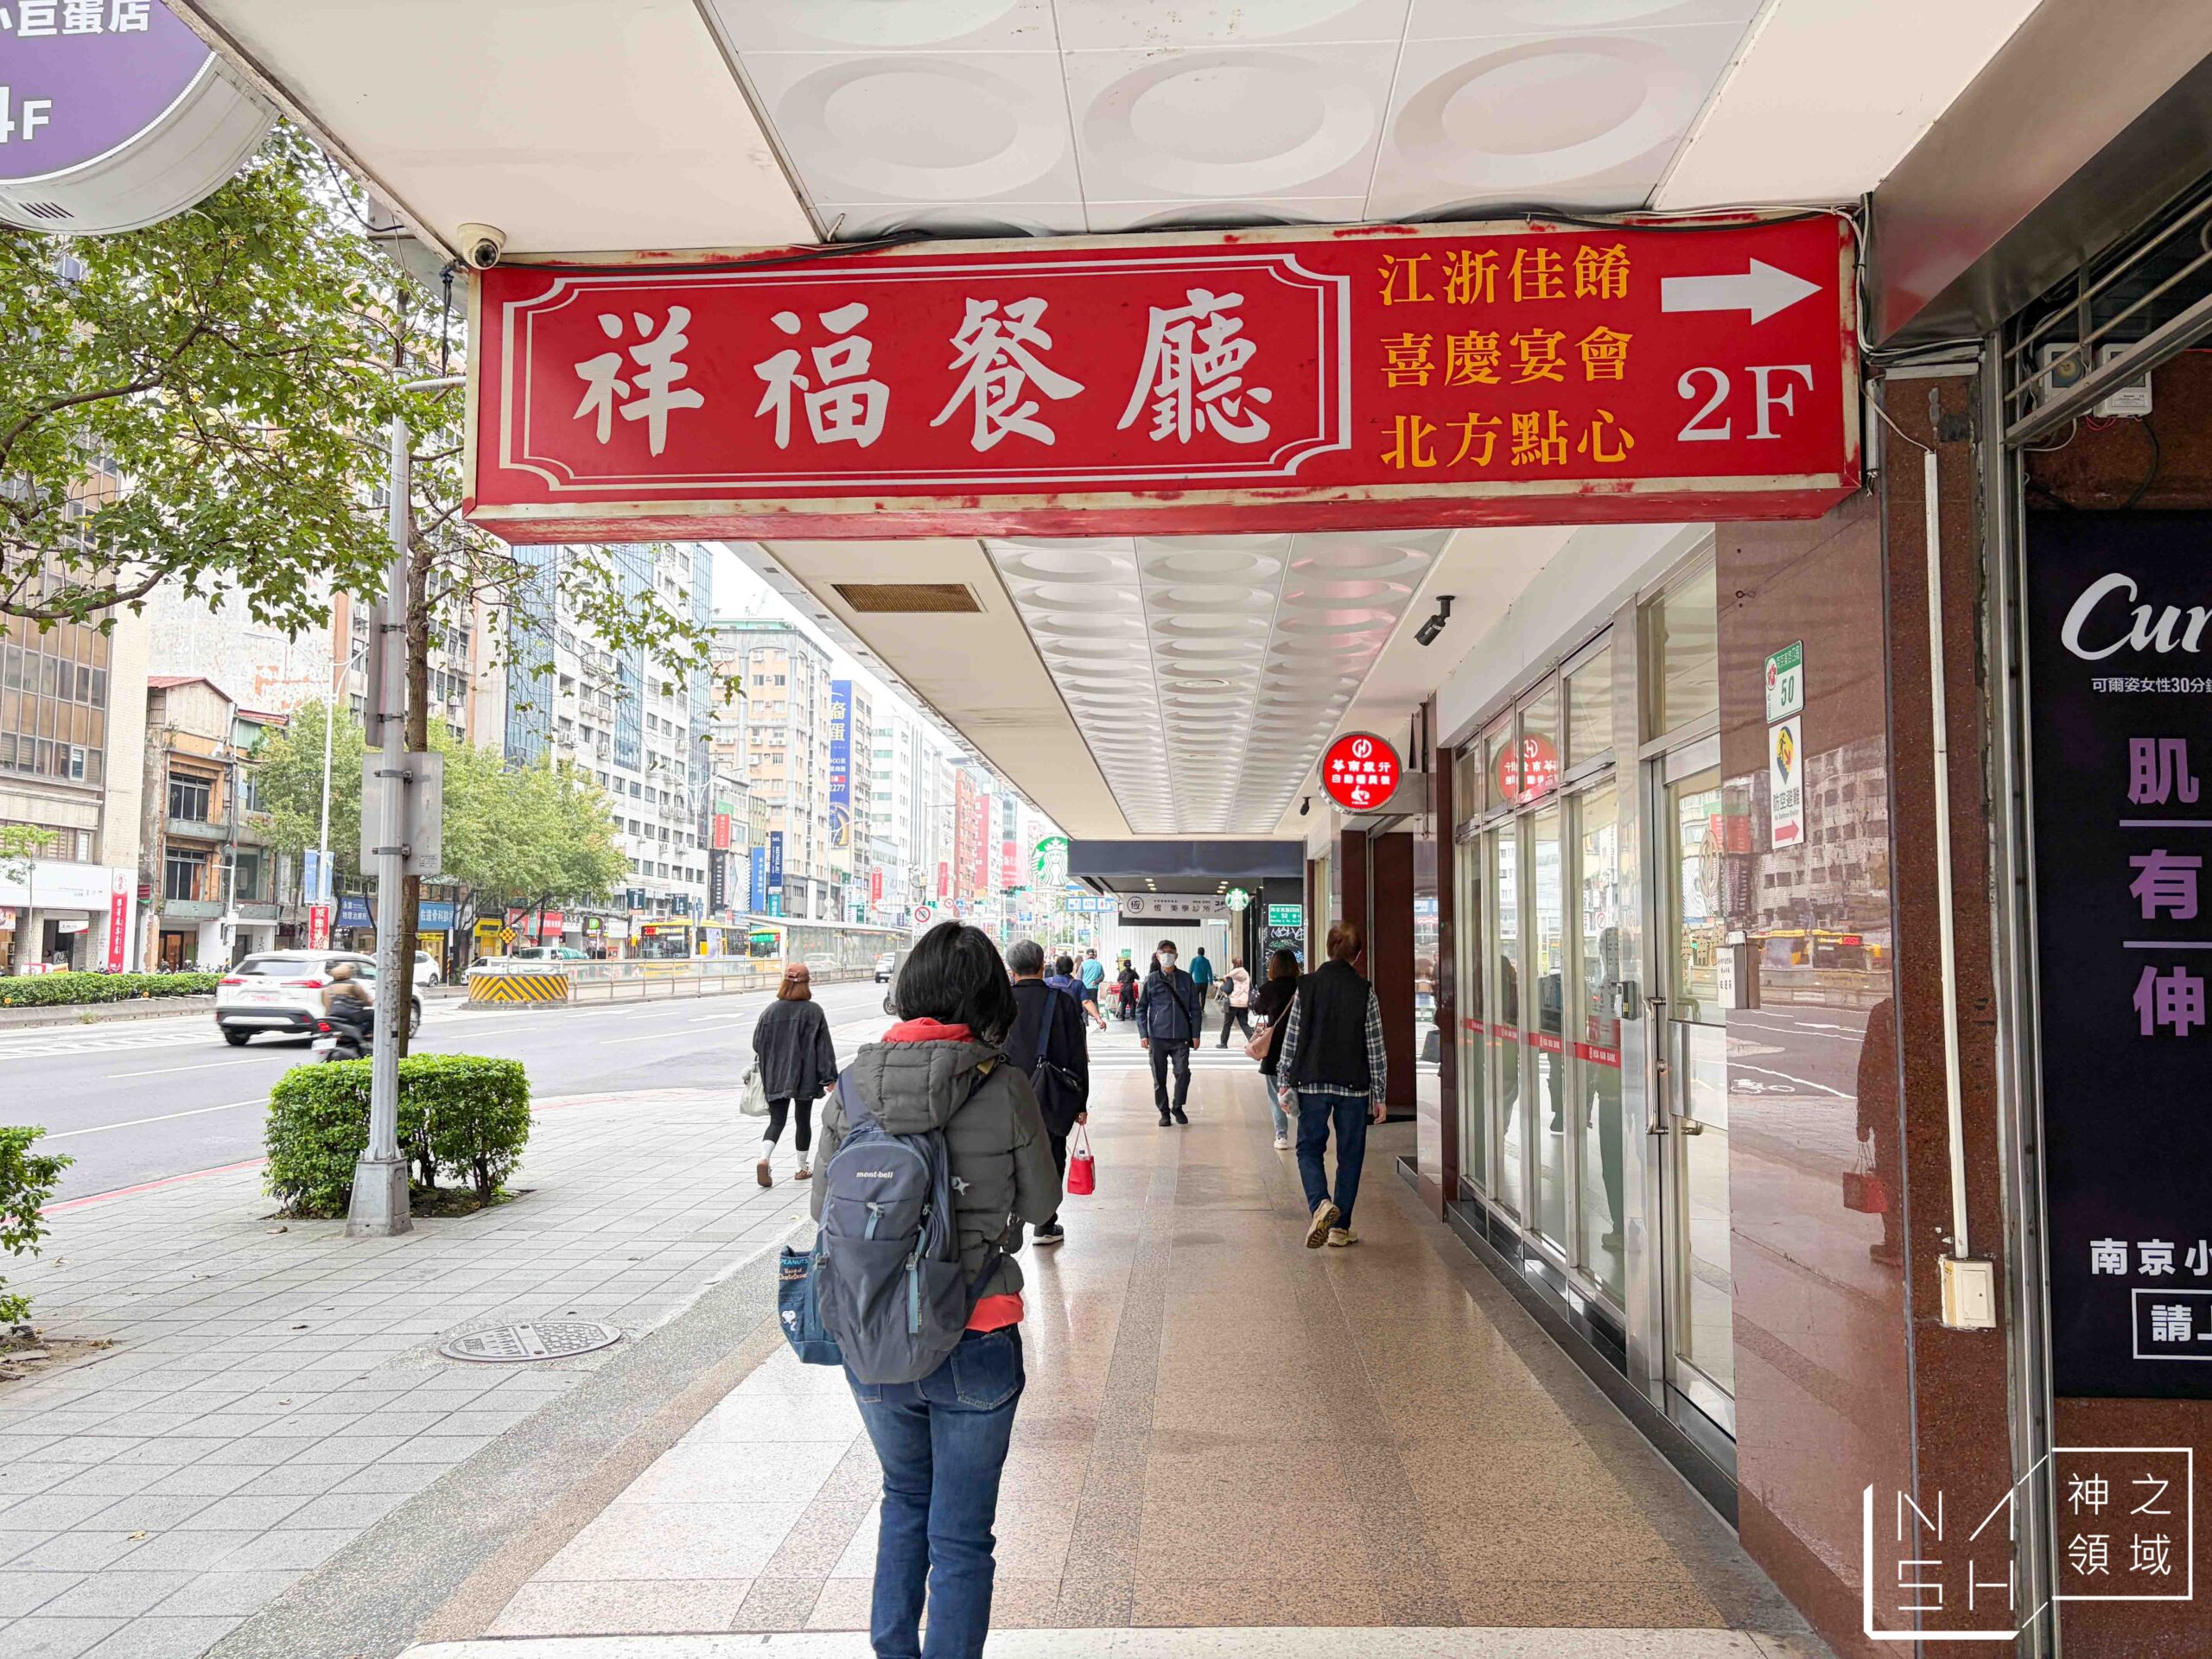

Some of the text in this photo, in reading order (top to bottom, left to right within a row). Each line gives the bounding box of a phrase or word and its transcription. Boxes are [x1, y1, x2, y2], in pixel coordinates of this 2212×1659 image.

[0, 0, 151, 37] 巨蛋店
[1376, 243, 1632, 307] 江浙佳餚
[571, 287, 1274, 457] 祥福餐廳
[1379, 325, 1635, 389] 喜慶宴會
[1676, 364, 1815, 442] 2F
[1380, 408, 1636, 470] 北方點心
[1781, 676, 1795, 707] 50
[1332, 759, 1392, 773] 華南銀行
[2126, 737, 2200, 805] 肌
[1773, 786, 1800, 811] 防空避難
[2128, 849, 2203, 919] 有
[2132, 964, 2206, 1037] 伸
